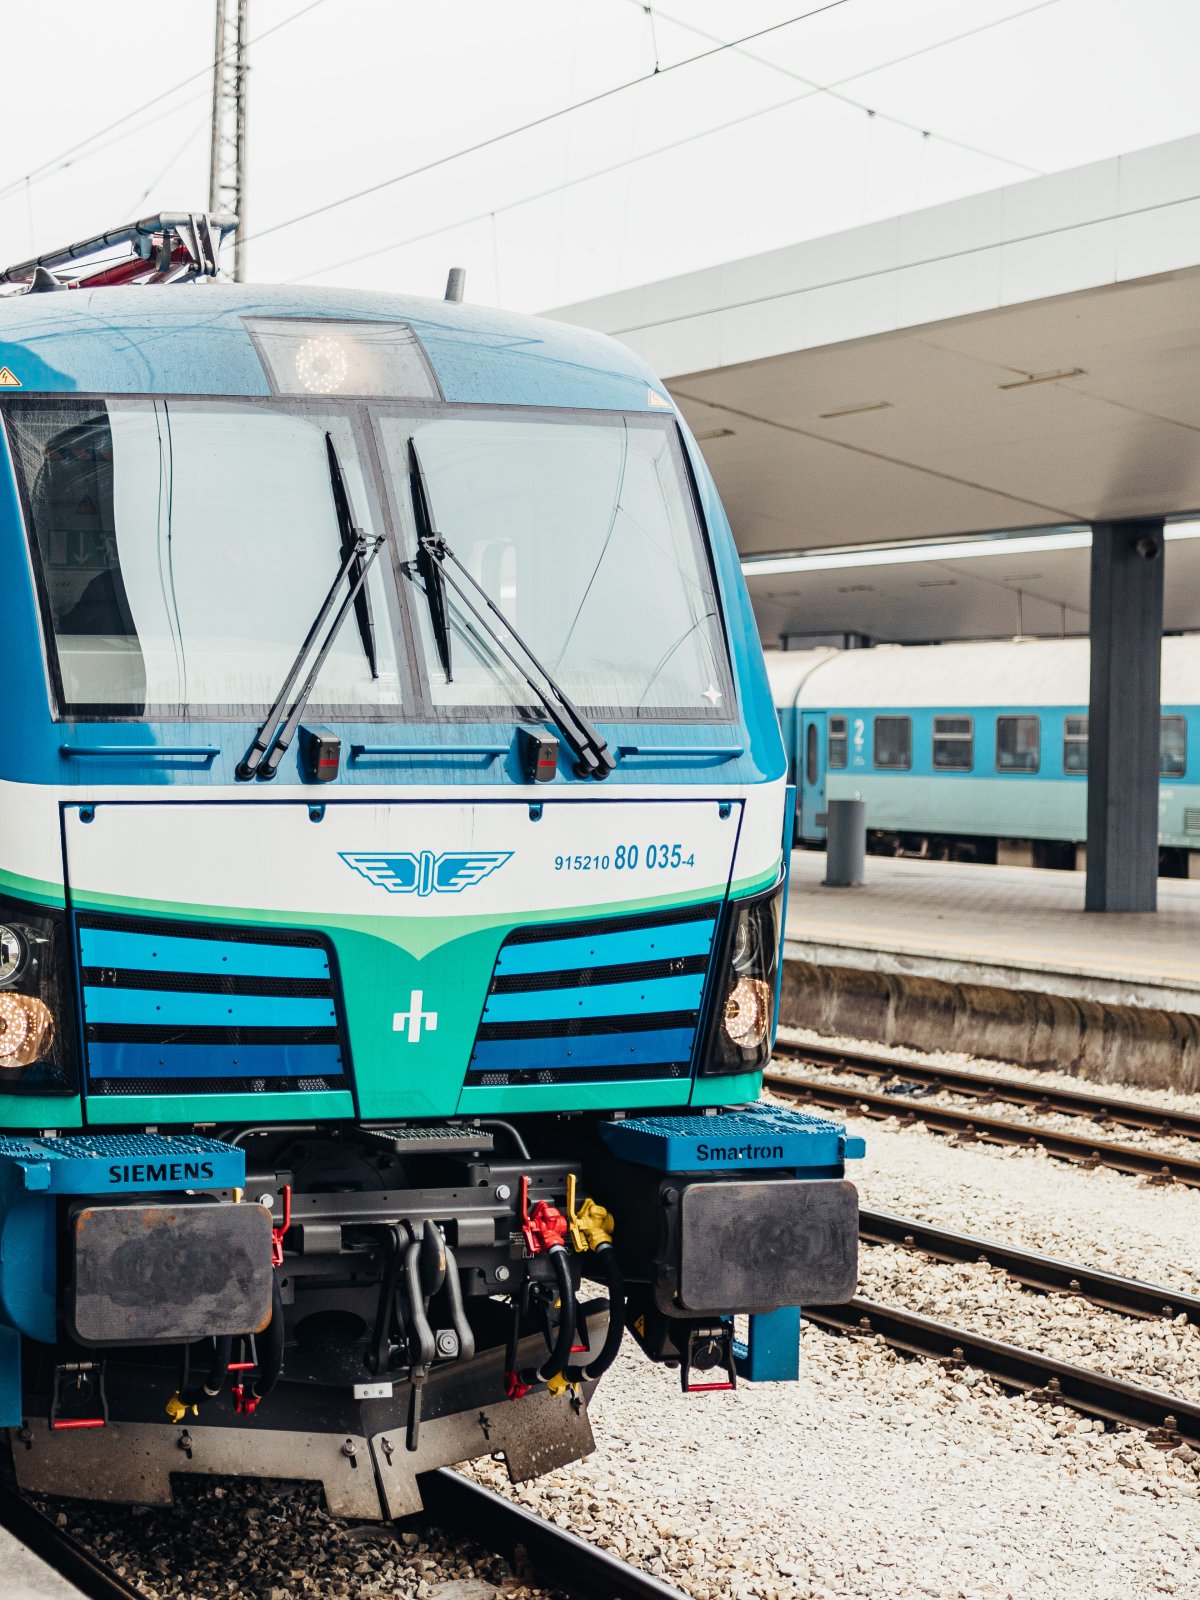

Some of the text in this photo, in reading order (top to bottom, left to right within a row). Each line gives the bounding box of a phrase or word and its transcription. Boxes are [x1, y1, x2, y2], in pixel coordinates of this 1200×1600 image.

[853, 718, 865, 745] 2
[553, 843, 695, 871] 915210 80 035-4
[696, 1143, 784, 1161] Smartron
[108, 1161, 214, 1183] SIEMENS
